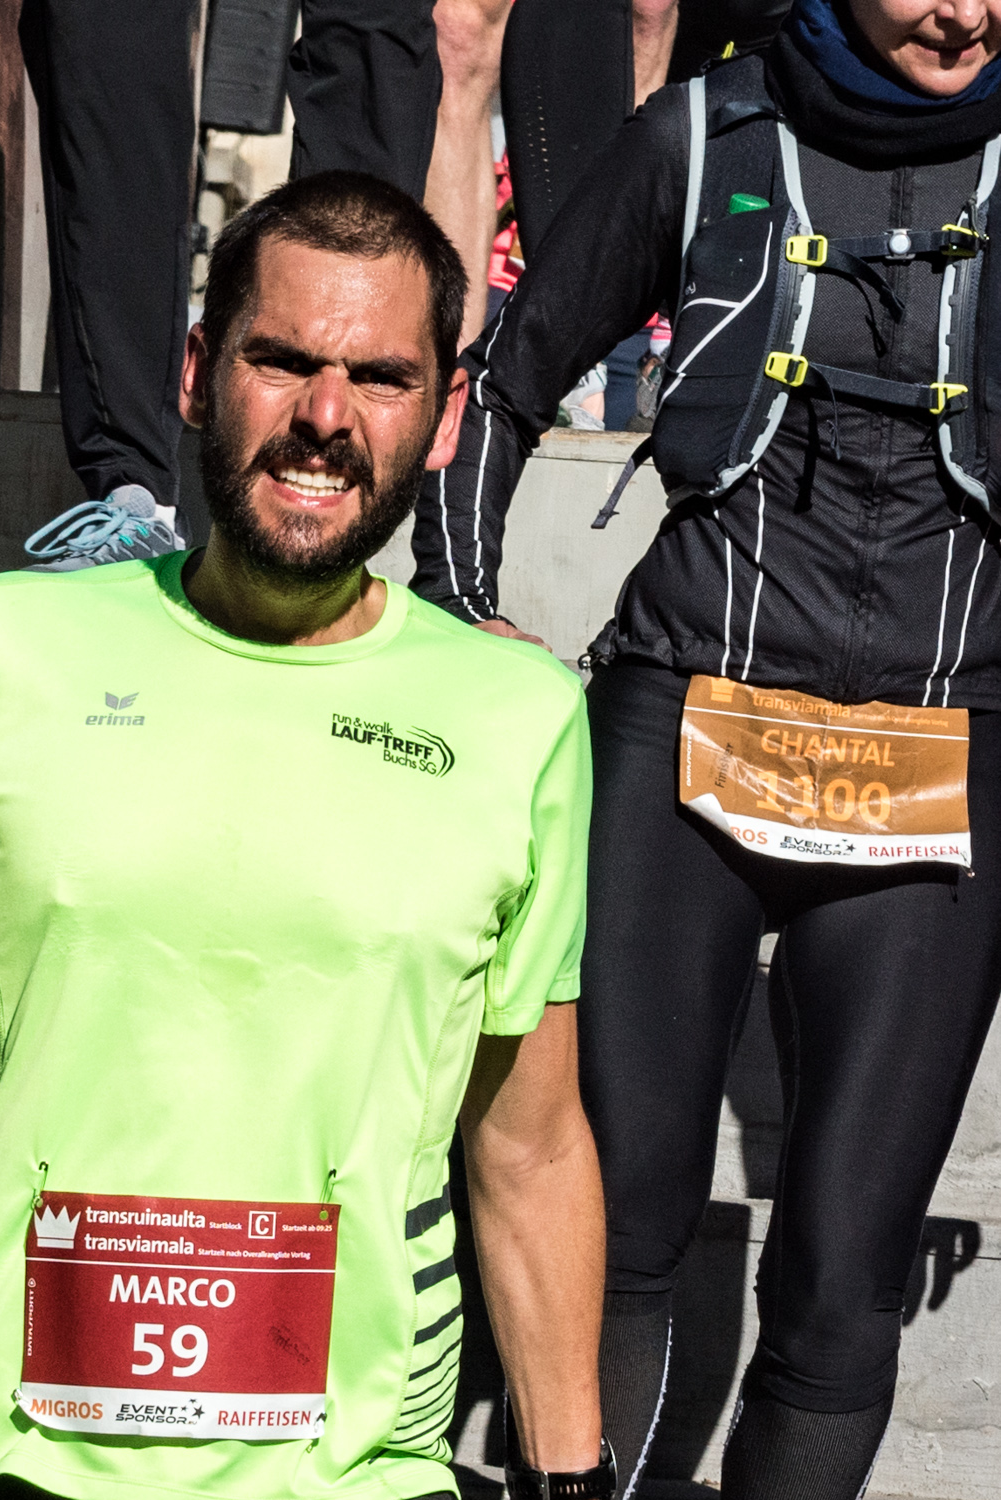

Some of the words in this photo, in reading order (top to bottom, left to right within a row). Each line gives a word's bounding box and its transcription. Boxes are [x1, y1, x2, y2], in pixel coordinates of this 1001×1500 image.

[752, 692, 851, 719] transviamala
[85, 713, 146, 726] erima
[332, 712, 352, 726] run
[353, 717, 363, 727] &
[363, 719, 394, 735] walk
[331, 721, 433, 761] LAUF-TREFF
[760, 728, 895, 768] CHANTAL
[383, 748, 417, 769] Buchs
[418, 758, 437, 775] SG
[713, 742, 734, 789] Finisher
[756, 769, 892, 825] 1100
[730, 825, 768, 846] ROS
[783, 835, 830, 850] EVENT
[868, 845, 960, 858] RAIFFEISEN
[85, 1206, 206, 1229] transruinaulta
[209, 1221, 243, 1231] Startblock
[255, 1214, 270, 1236] C
[84, 1232, 195, 1255] transviamala
[226, 1249, 242, 1258] nach
[109, 1274, 237, 1309] MARCO
[131, 1322, 209, 1378] 59
[30, 1399, 103, 1420] MIGROS
[120, 1403, 179, 1416] EVENT
[217, 1410, 312, 1427] RAIFFEISEN
